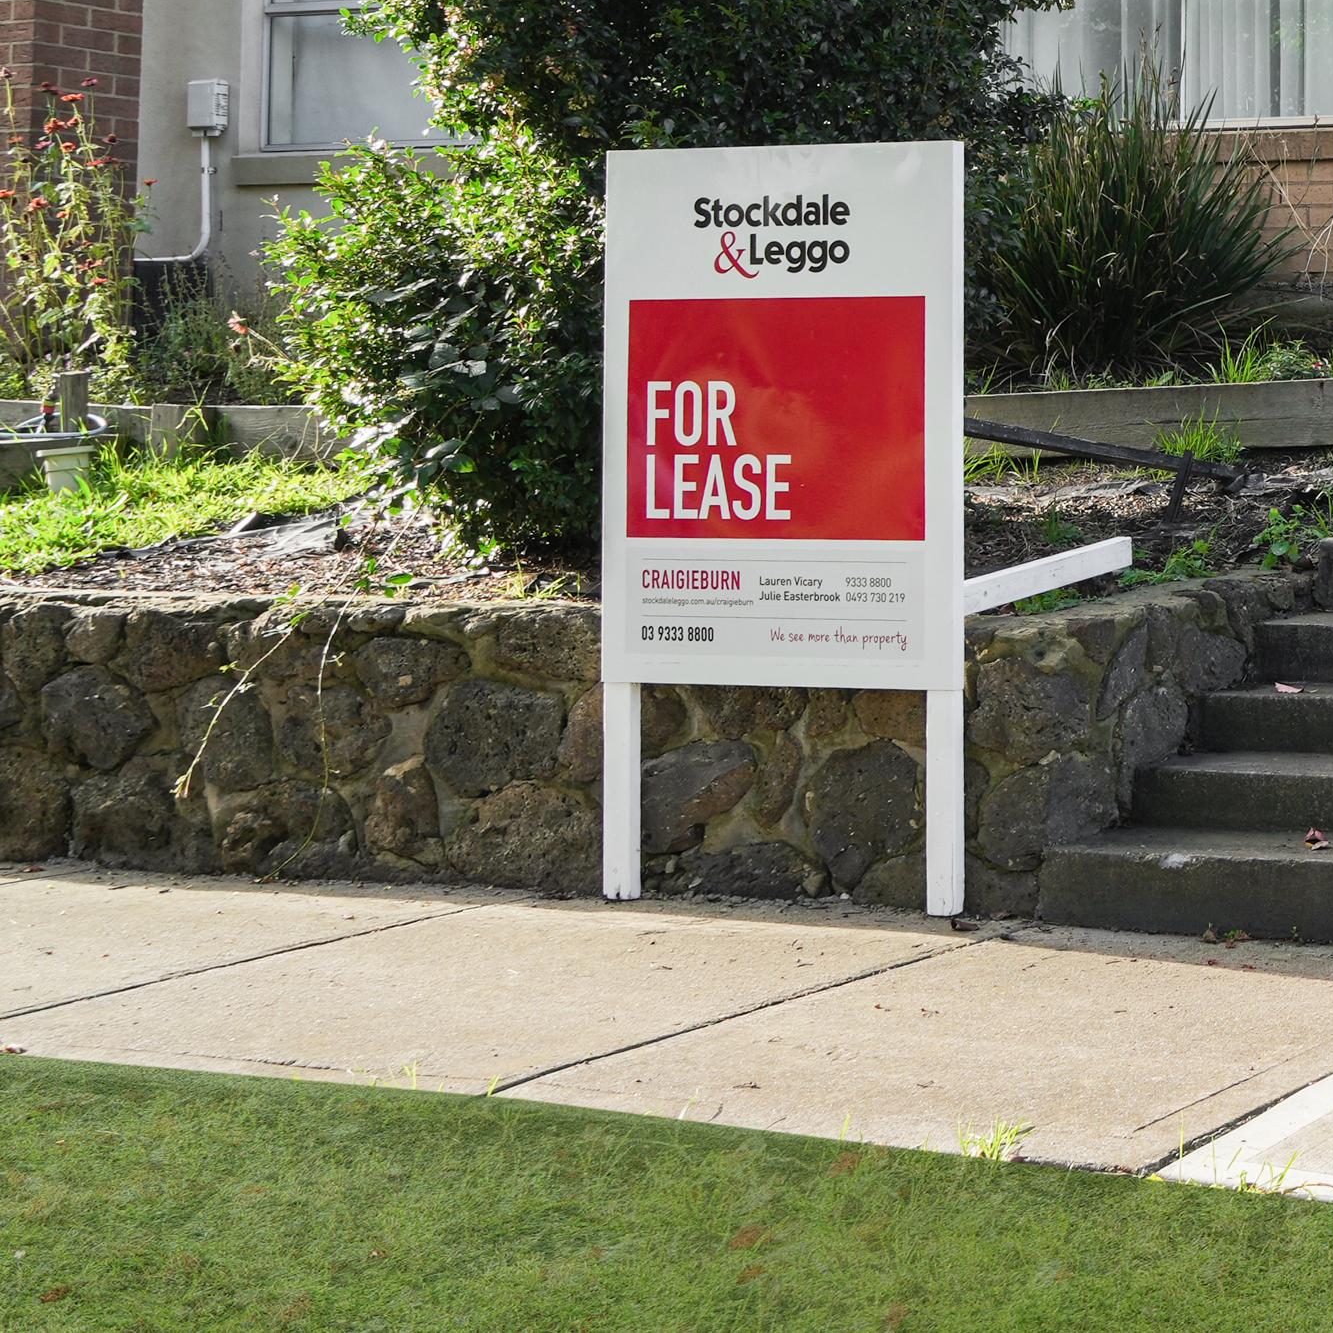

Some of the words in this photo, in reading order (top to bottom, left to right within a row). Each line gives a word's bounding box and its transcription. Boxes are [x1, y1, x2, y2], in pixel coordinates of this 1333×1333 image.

[693, 193, 851, 229] Stockdale
[749, 233, 851, 273] Leggo
[645, 379, 737, 447] FOR
[645, 452, 792, 521] LEASE
[641, 569, 741, 590] CRAIGIEBURN
[758, 575, 792, 587] Lauren
[793, 575, 824, 590] Vicary
[845, 576, 868, 588] 9333
[869, 577, 892, 589] 8800
[641, 596, 754, 608] stockdaleleggo.com.au/craigieburn
[758, 590, 782, 602] Julie
[783, 590, 841, 602] Easterbrook
[845, 592, 868, 603] 0493
[870, 592, 887, 603] 730
[888, 592, 906, 604] 219
[641, 625, 655, 641] 03
[657, 625, 684, 642] 9333
[687, 626, 715, 642] 8800
[769, 626, 786, 642] We
[788, 631, 805, 643] see
[807, 632, 831, 643] more
[834, 625, 859, 644] than
[862, 629, 909, 652] property
